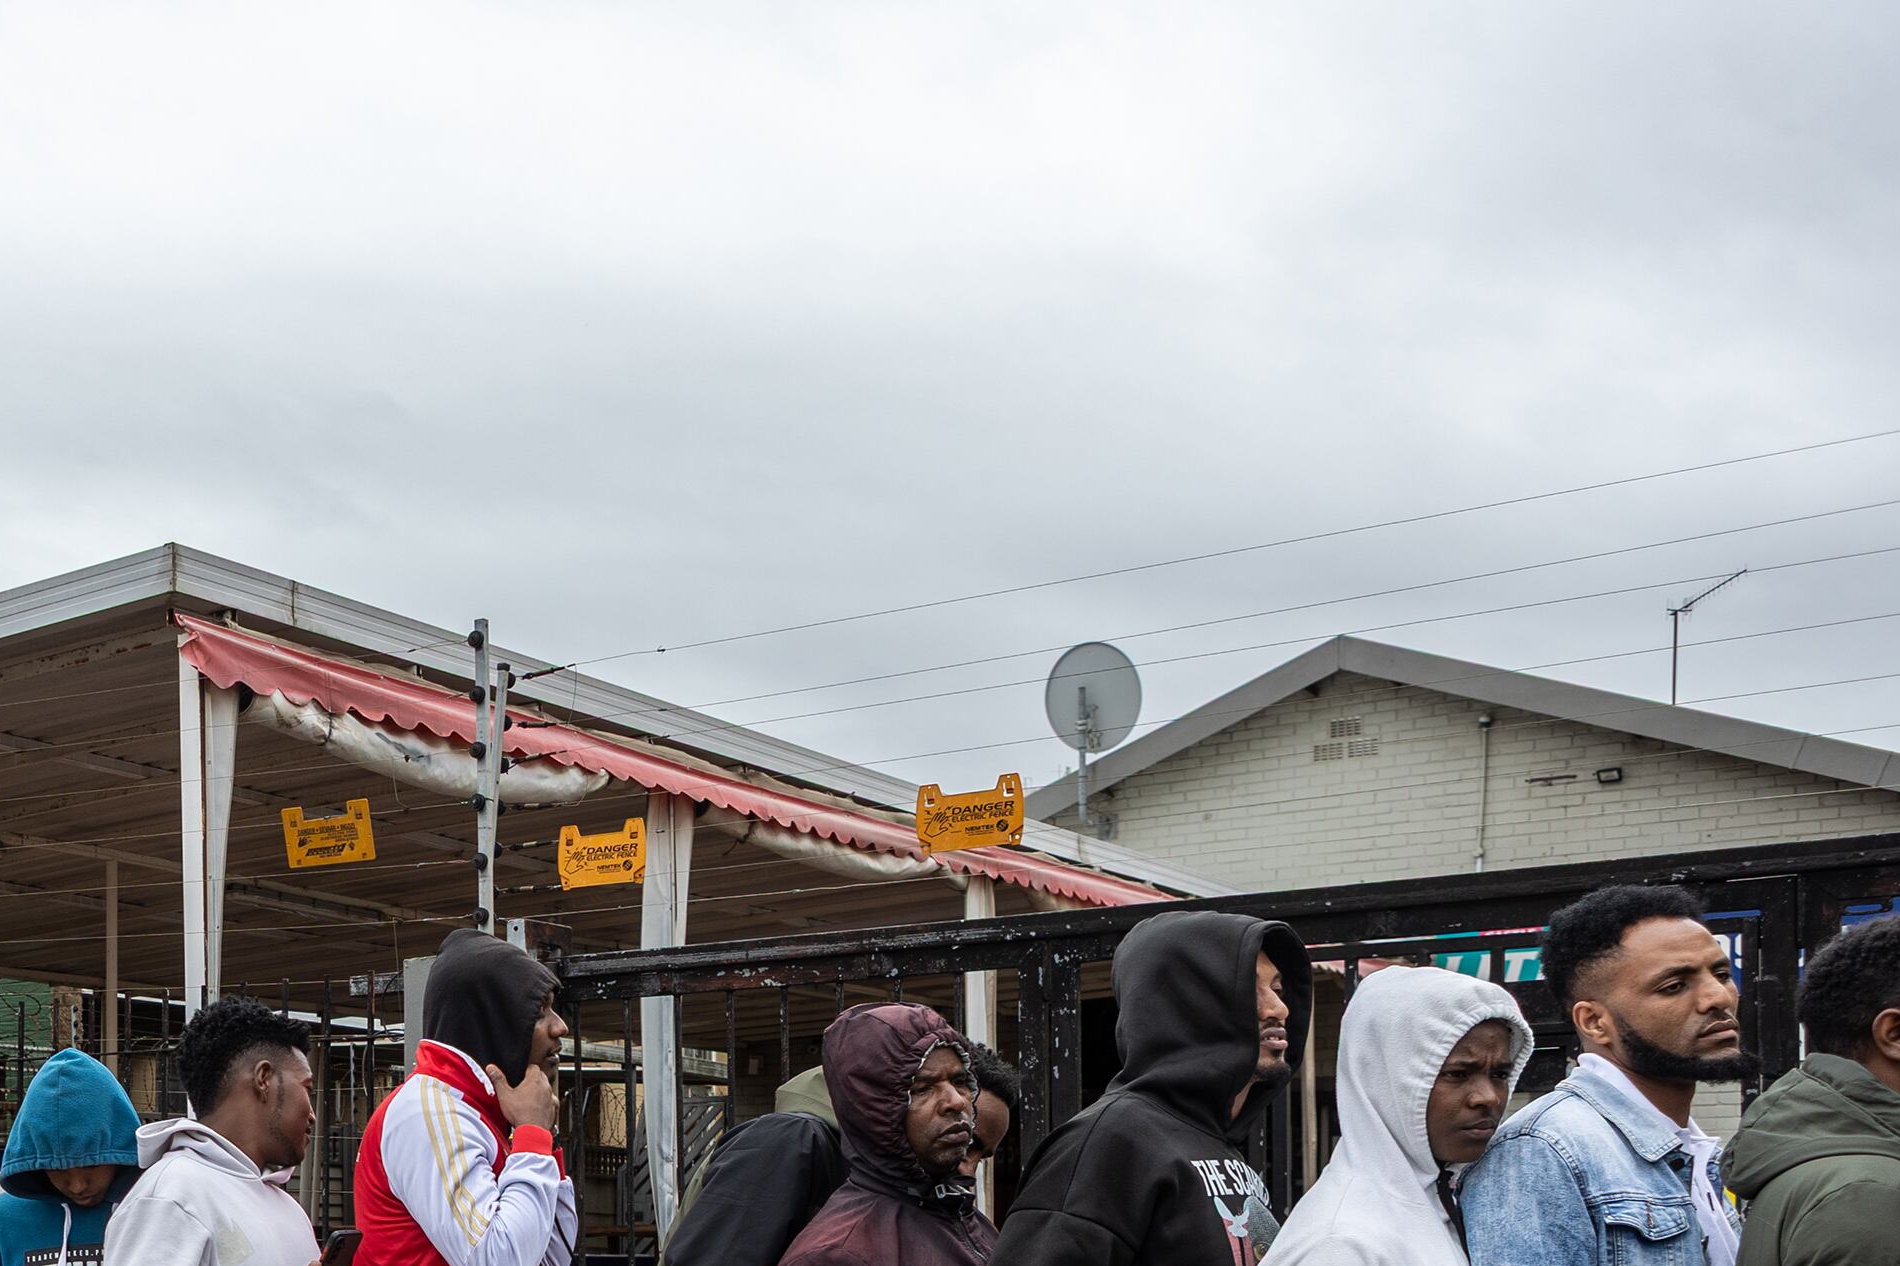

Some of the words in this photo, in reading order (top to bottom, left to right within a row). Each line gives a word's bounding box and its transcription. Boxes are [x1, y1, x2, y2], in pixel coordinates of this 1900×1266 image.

[952, 800, 1015, 815] DANGER
[952, 812, 986, 822] ELECTRIC
[988, 808, 1015, 819] FENCE
[586, 843, 638, 855] DANGER
[586, 852, 614, 862] ELECTRIC
[616, 848, 638, 859] FENCE
[1190, 1160, 1234, 1197] THE
